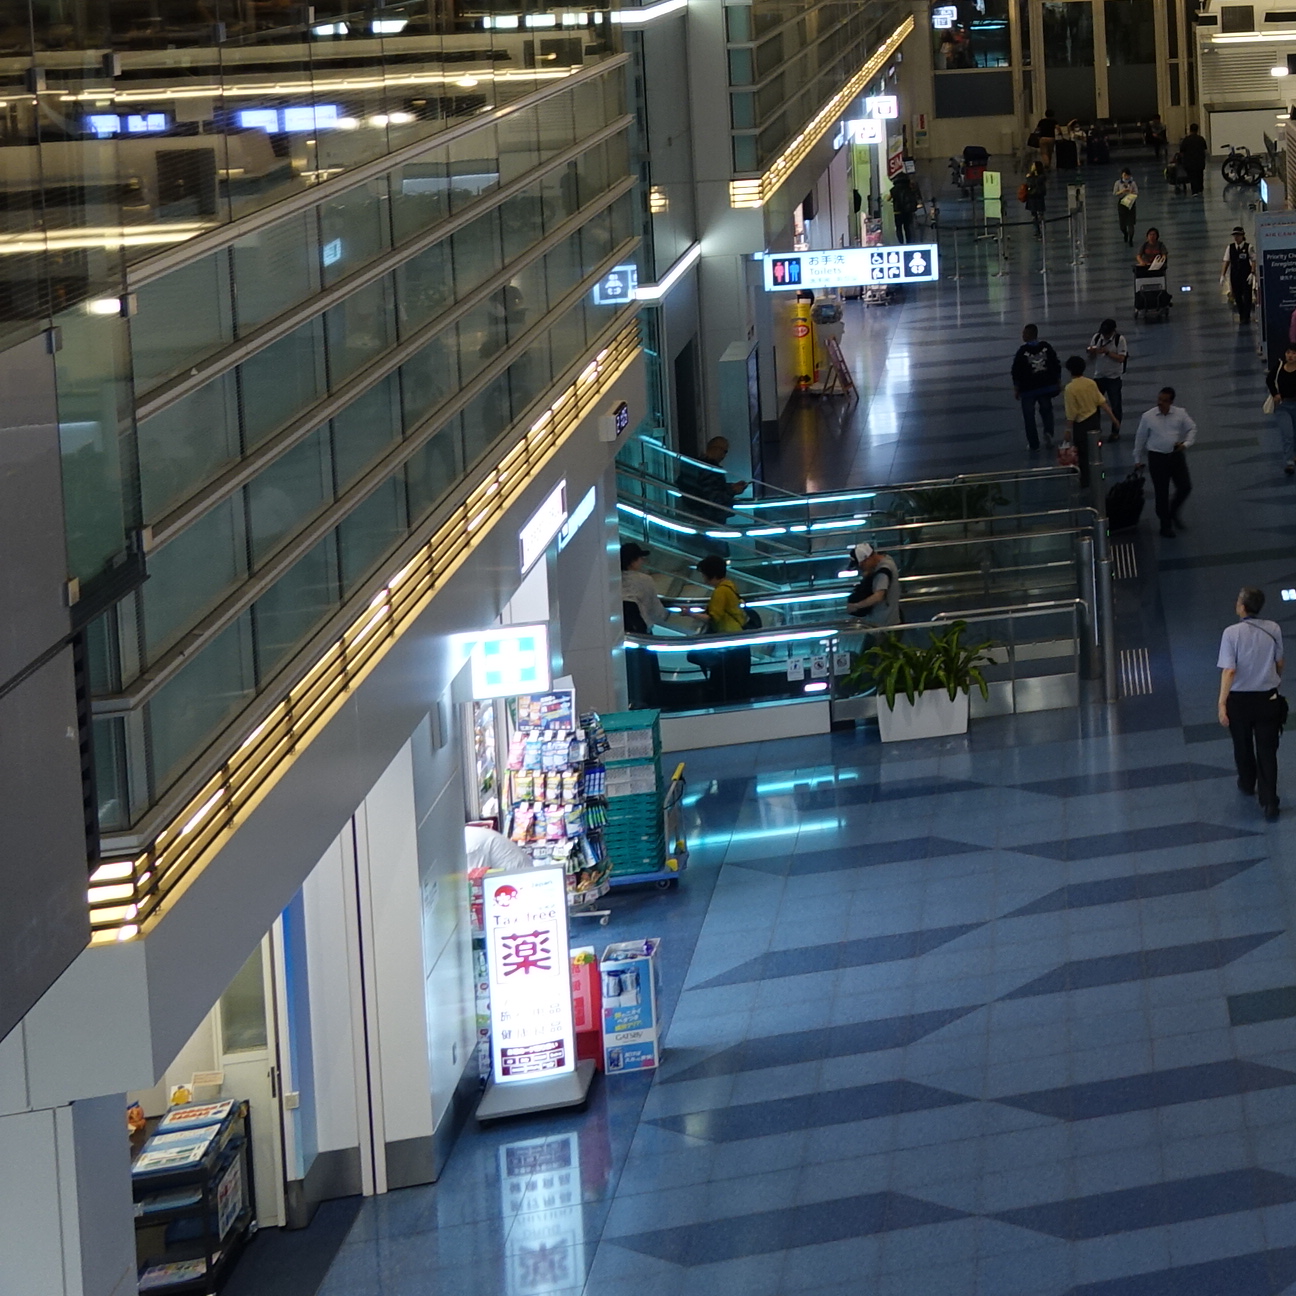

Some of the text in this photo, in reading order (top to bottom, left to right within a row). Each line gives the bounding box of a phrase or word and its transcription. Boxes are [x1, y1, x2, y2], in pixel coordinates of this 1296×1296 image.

[808, 255, 845, 265] お手洗
[500, 929, 552, 977] 薬
